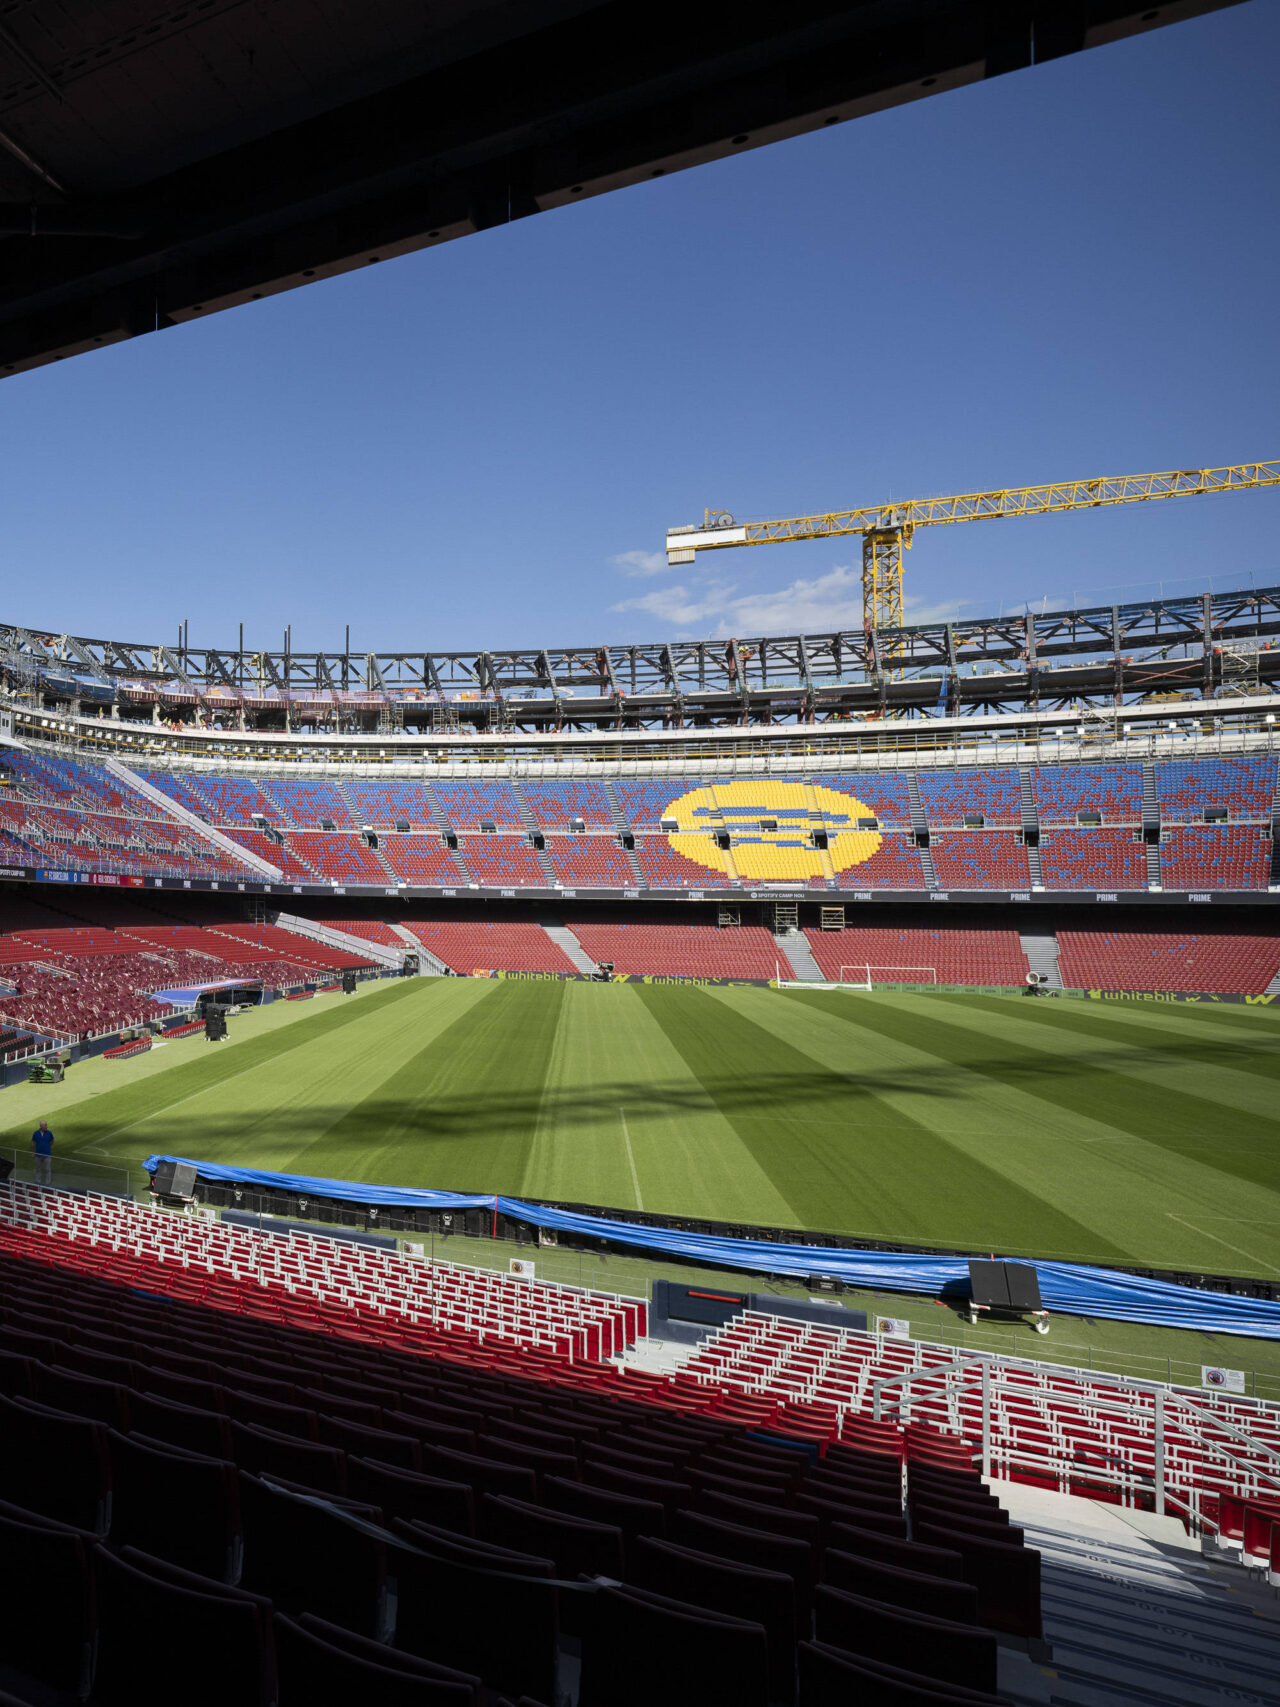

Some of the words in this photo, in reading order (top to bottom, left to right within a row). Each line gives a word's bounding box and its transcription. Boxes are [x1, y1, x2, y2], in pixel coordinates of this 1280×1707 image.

[929, 893, 950, 901] PRIME
[1010, 893, 1031, 901] PRIME
[1096, 893, 1118, 902] PRIME
[1188, 894, 1212, 903] PRIME
[507, 970, 561, 981] whitebit
[1104, 989, 1178, 1002] whitebit
